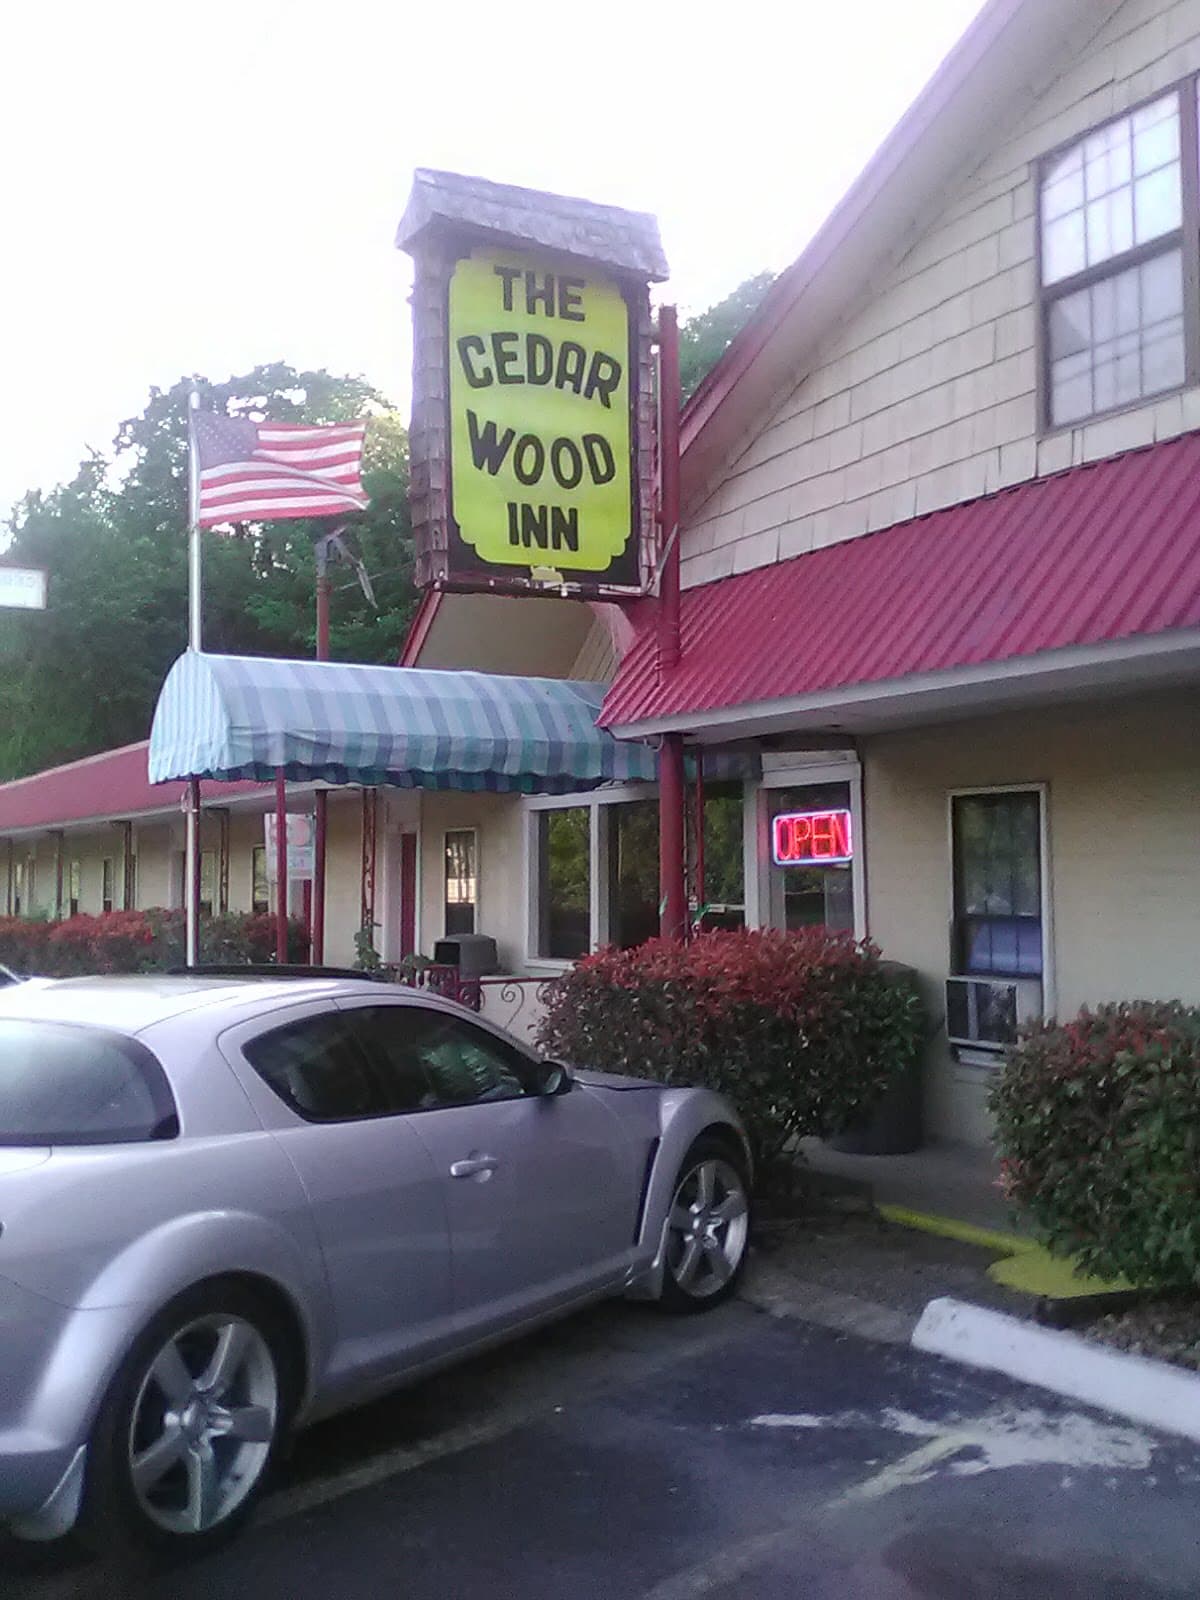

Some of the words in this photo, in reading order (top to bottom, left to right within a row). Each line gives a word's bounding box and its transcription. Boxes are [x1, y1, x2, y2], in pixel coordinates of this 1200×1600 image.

[494, 265, 586, 322] THE
[456, 331, 622, 409] CEDAR
[466, 408, 616, 489] WOOD
[507, 502, 579, 551] INN
[777, 814, 851, 860] OPEN
